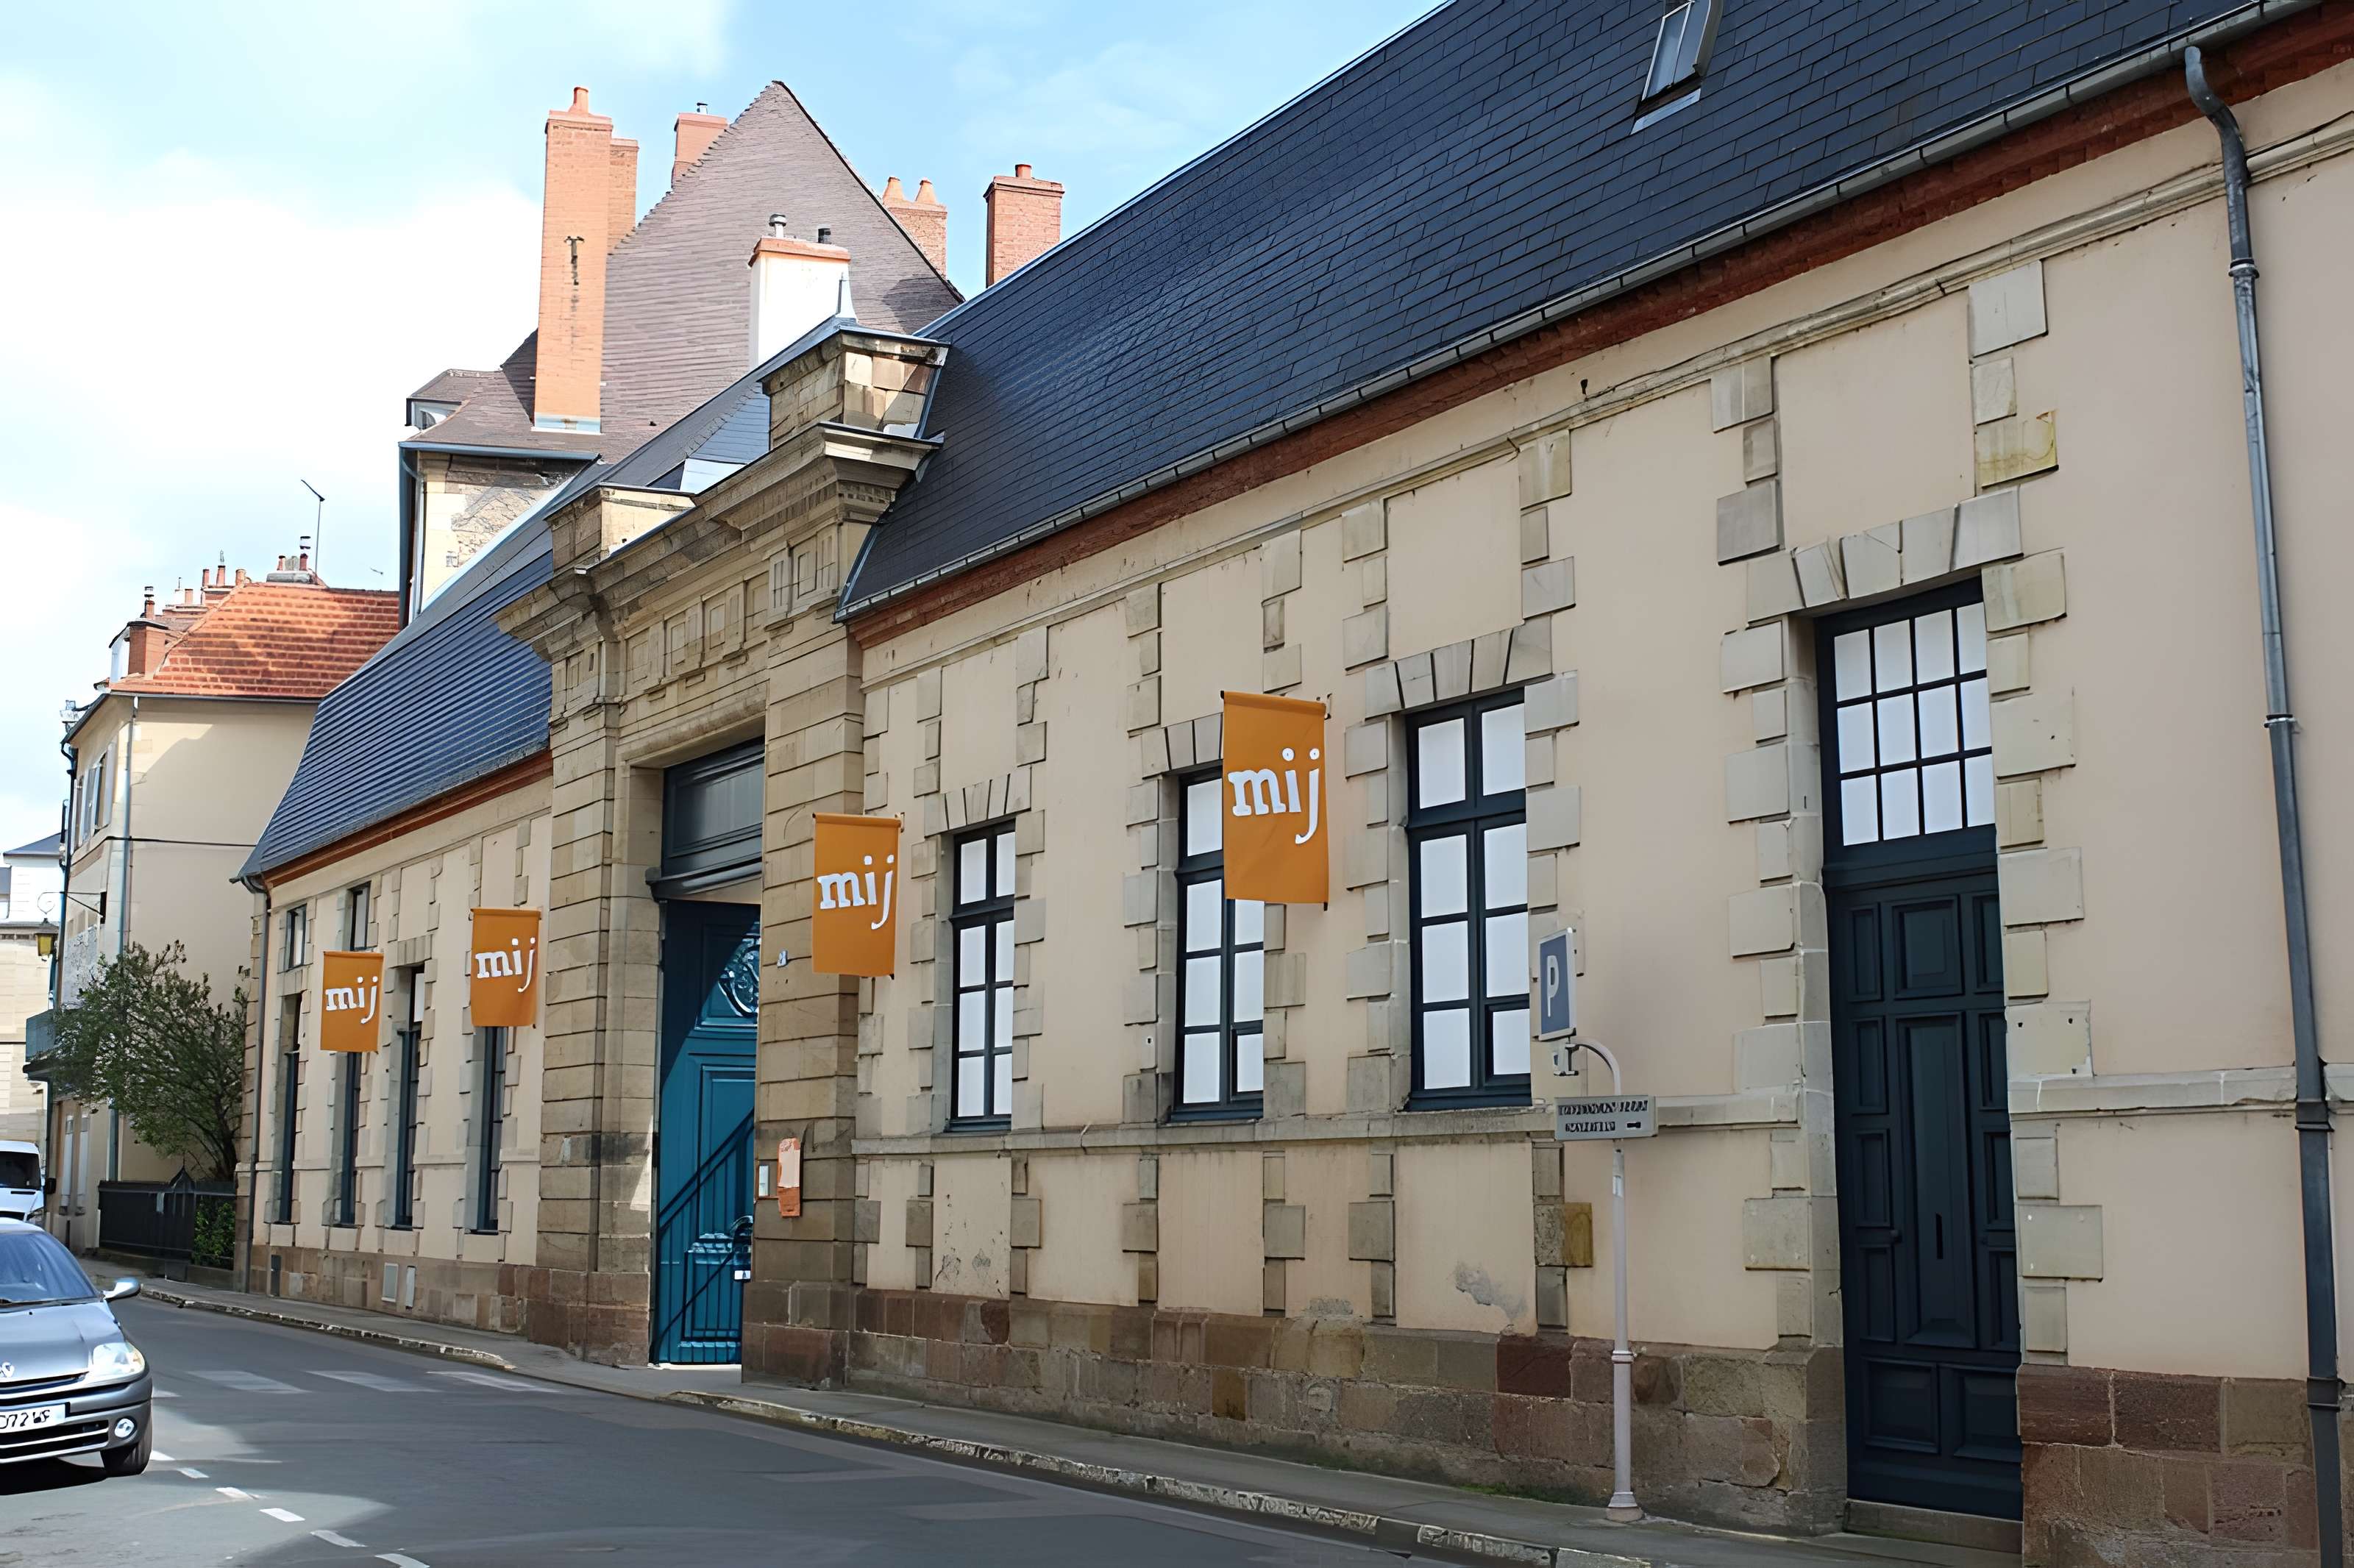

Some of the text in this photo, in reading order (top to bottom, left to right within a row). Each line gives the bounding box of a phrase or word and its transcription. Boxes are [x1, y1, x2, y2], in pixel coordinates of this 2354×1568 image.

[1228, 748, 1319, 844] mij
[817, 855, 895, 930] mij
[475, 937, 536, 993] mij
[1546, 955, 1560, 1017] P
[325, 976, 378, 1024] mij
